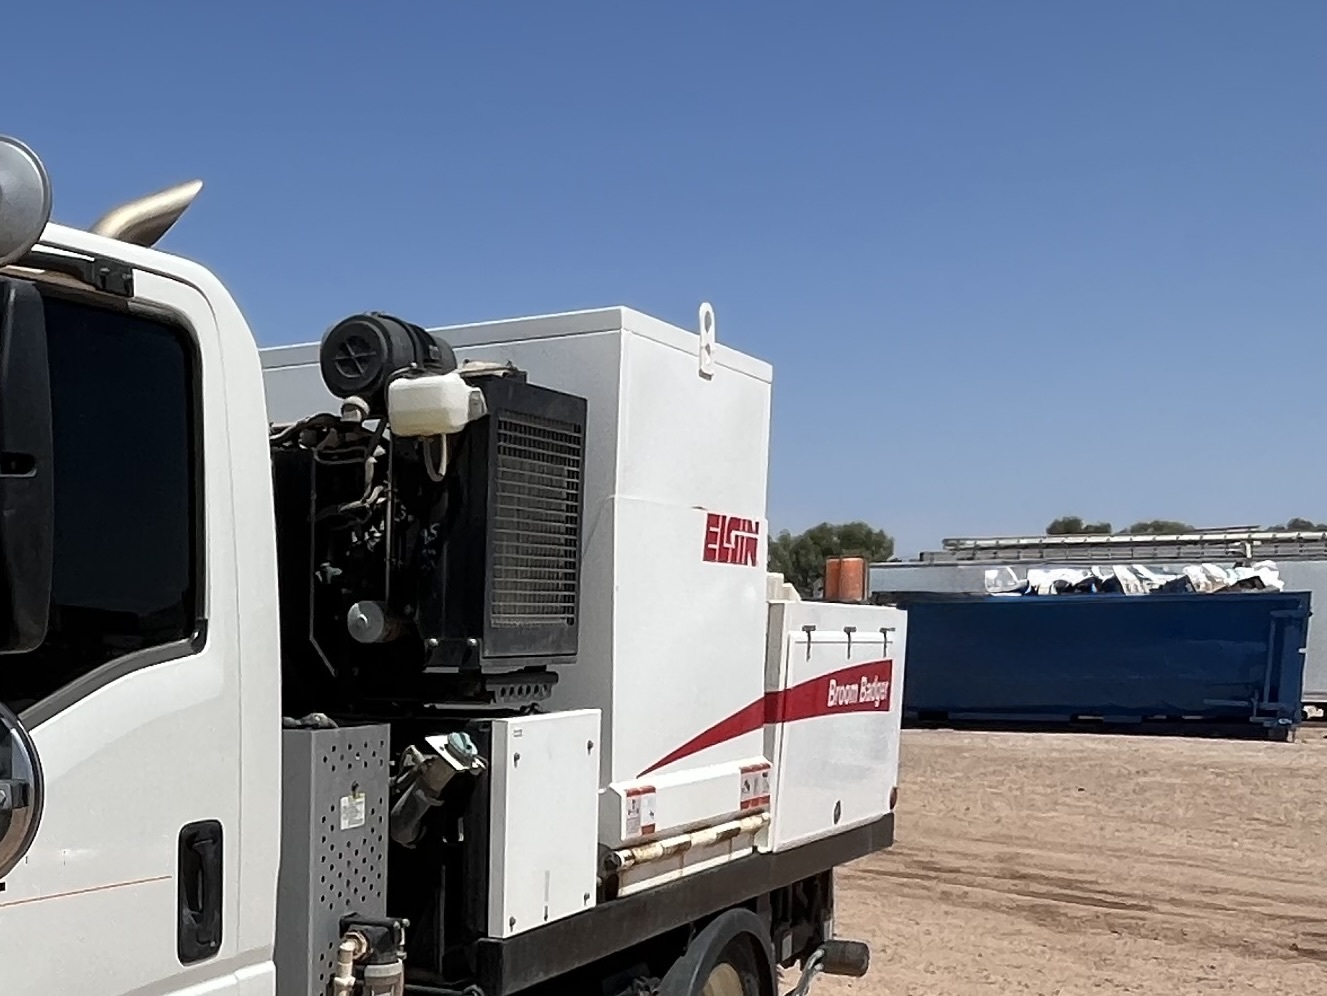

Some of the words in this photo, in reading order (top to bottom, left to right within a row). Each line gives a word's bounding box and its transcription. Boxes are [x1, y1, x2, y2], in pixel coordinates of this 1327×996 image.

[703, 512, 759, 567] ELGIN
[827, 679, 859, 707] Broom
[859, 675, 889, 708] Badger
